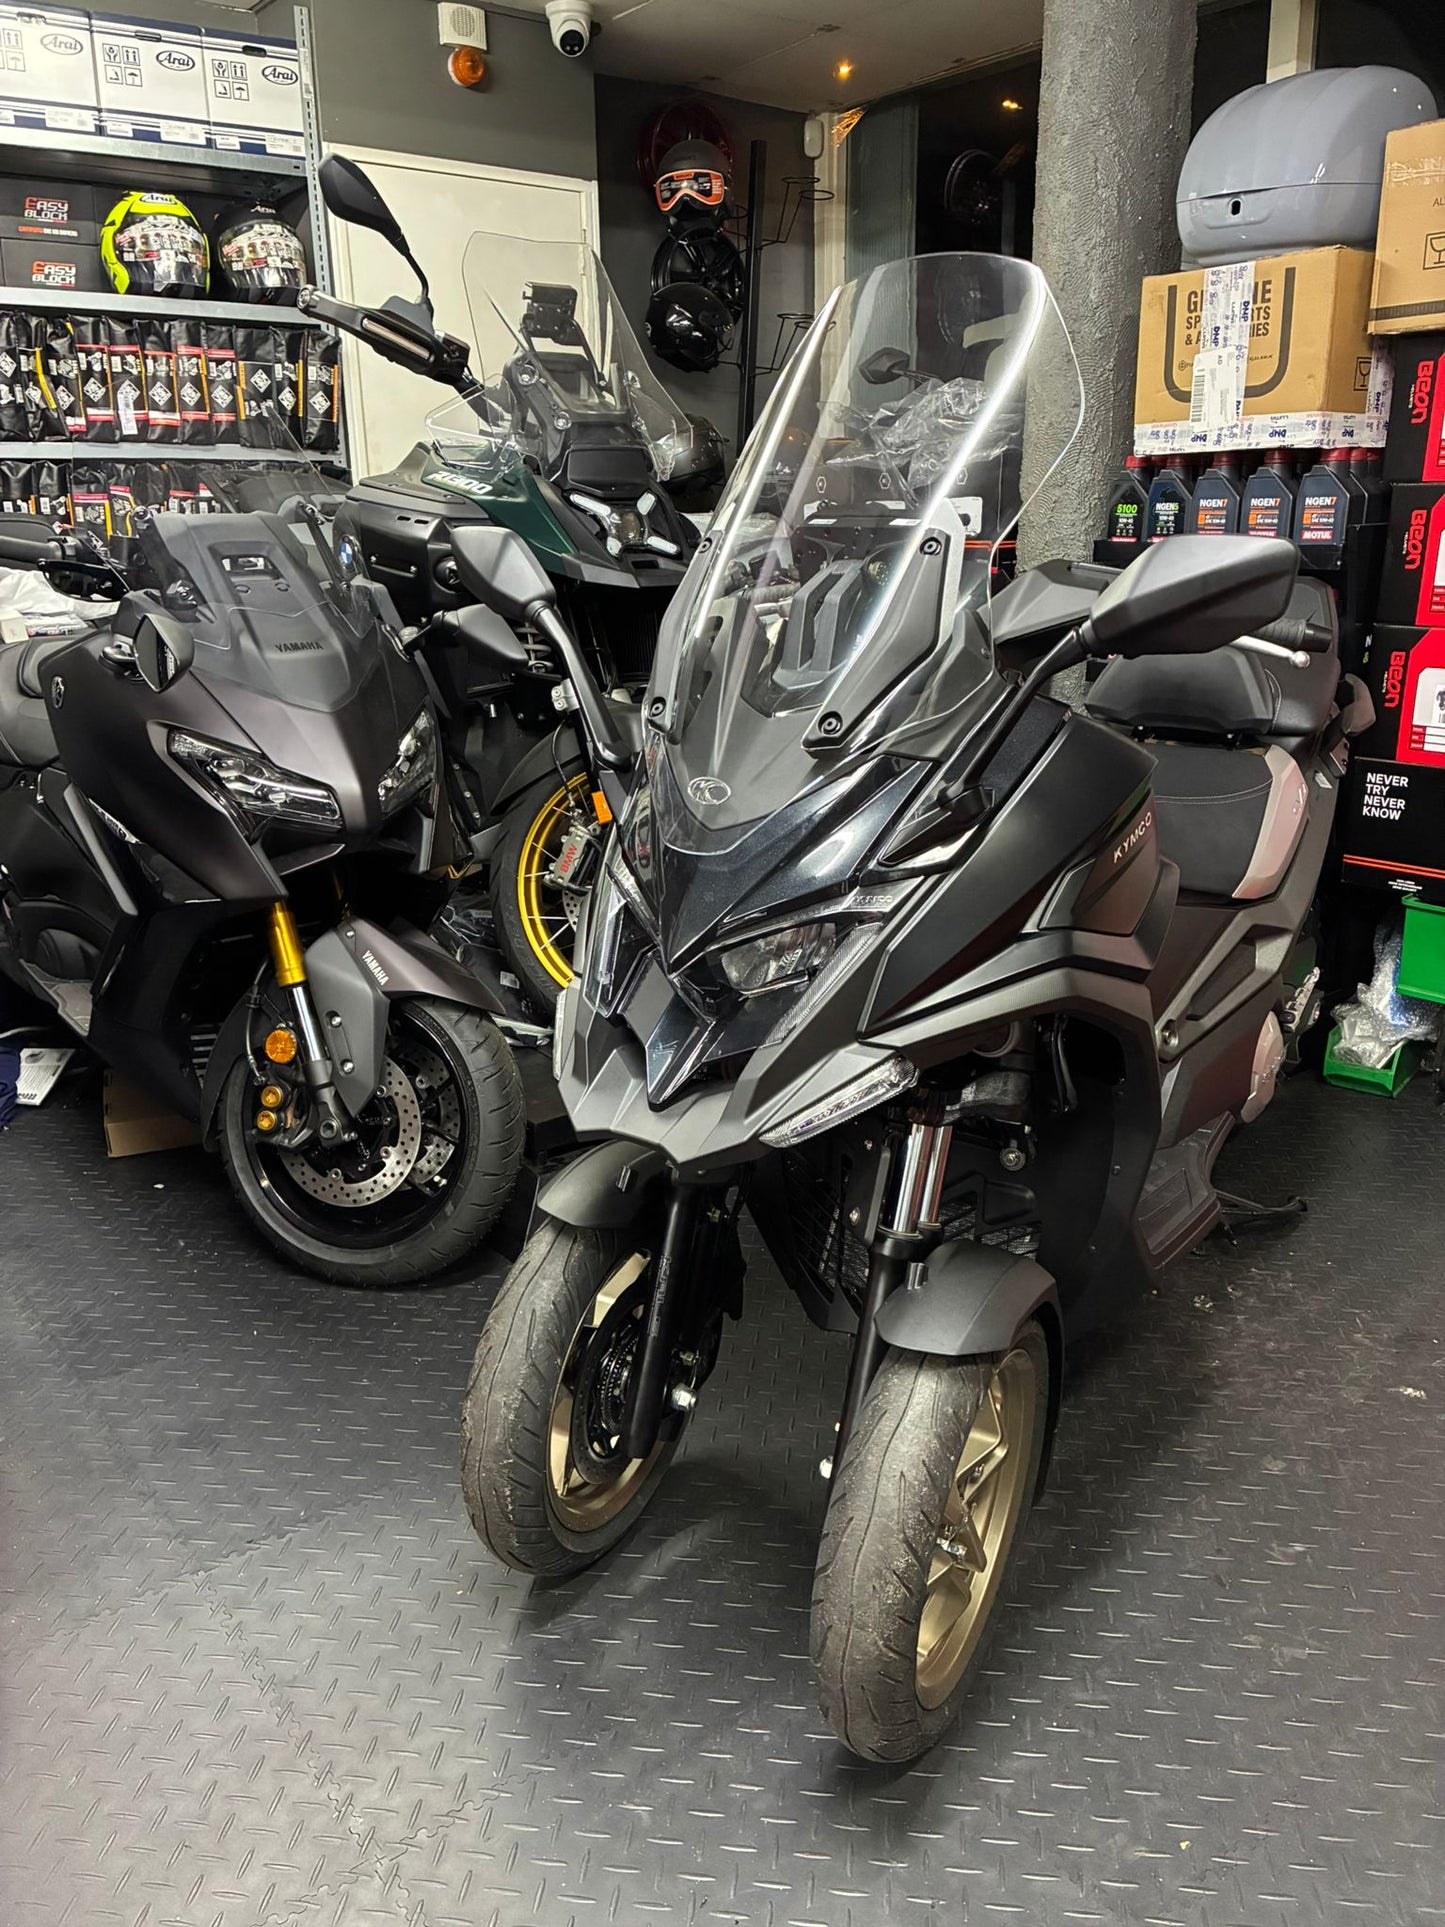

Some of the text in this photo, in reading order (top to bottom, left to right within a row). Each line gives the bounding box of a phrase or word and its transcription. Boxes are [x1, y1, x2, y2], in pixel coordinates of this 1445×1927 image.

[47, 35, 79, 51] Arai
[163, 52, 191, 68] Arai
[268, 66, 294, 82] Arai
[25, 197, 69, 213] EASY
[24, 209, 68, 221] BLOCK
[32, 260, 76, 276] EASY
[32, 273, 76, 285] BLOCK
[1117, 503, 1138, 514] 5100
[1155, 502, 1179, 511] NGEN5
[1199, 498, 1228, 507] NGEN7
[1250, 498, 1281, 507] NGEN7
[1305, 496, 1337, 506] NGEN7
[1302, 530, 1332, 539] MOTUL
[275, 641, 324, 653] YAMAHA
[1366, 772, 1409, 788] NEVER
[1365, 783, 1390, 796] TRY
[1363, 794, 1406, 810] NEVER
[1362, 805, 1402, 821] KNOW
[1113, 811, 1152, 864] KYMCO
[559, 843, 578, 873] BMW
[362, 949, 390, 986] YAMAHA
